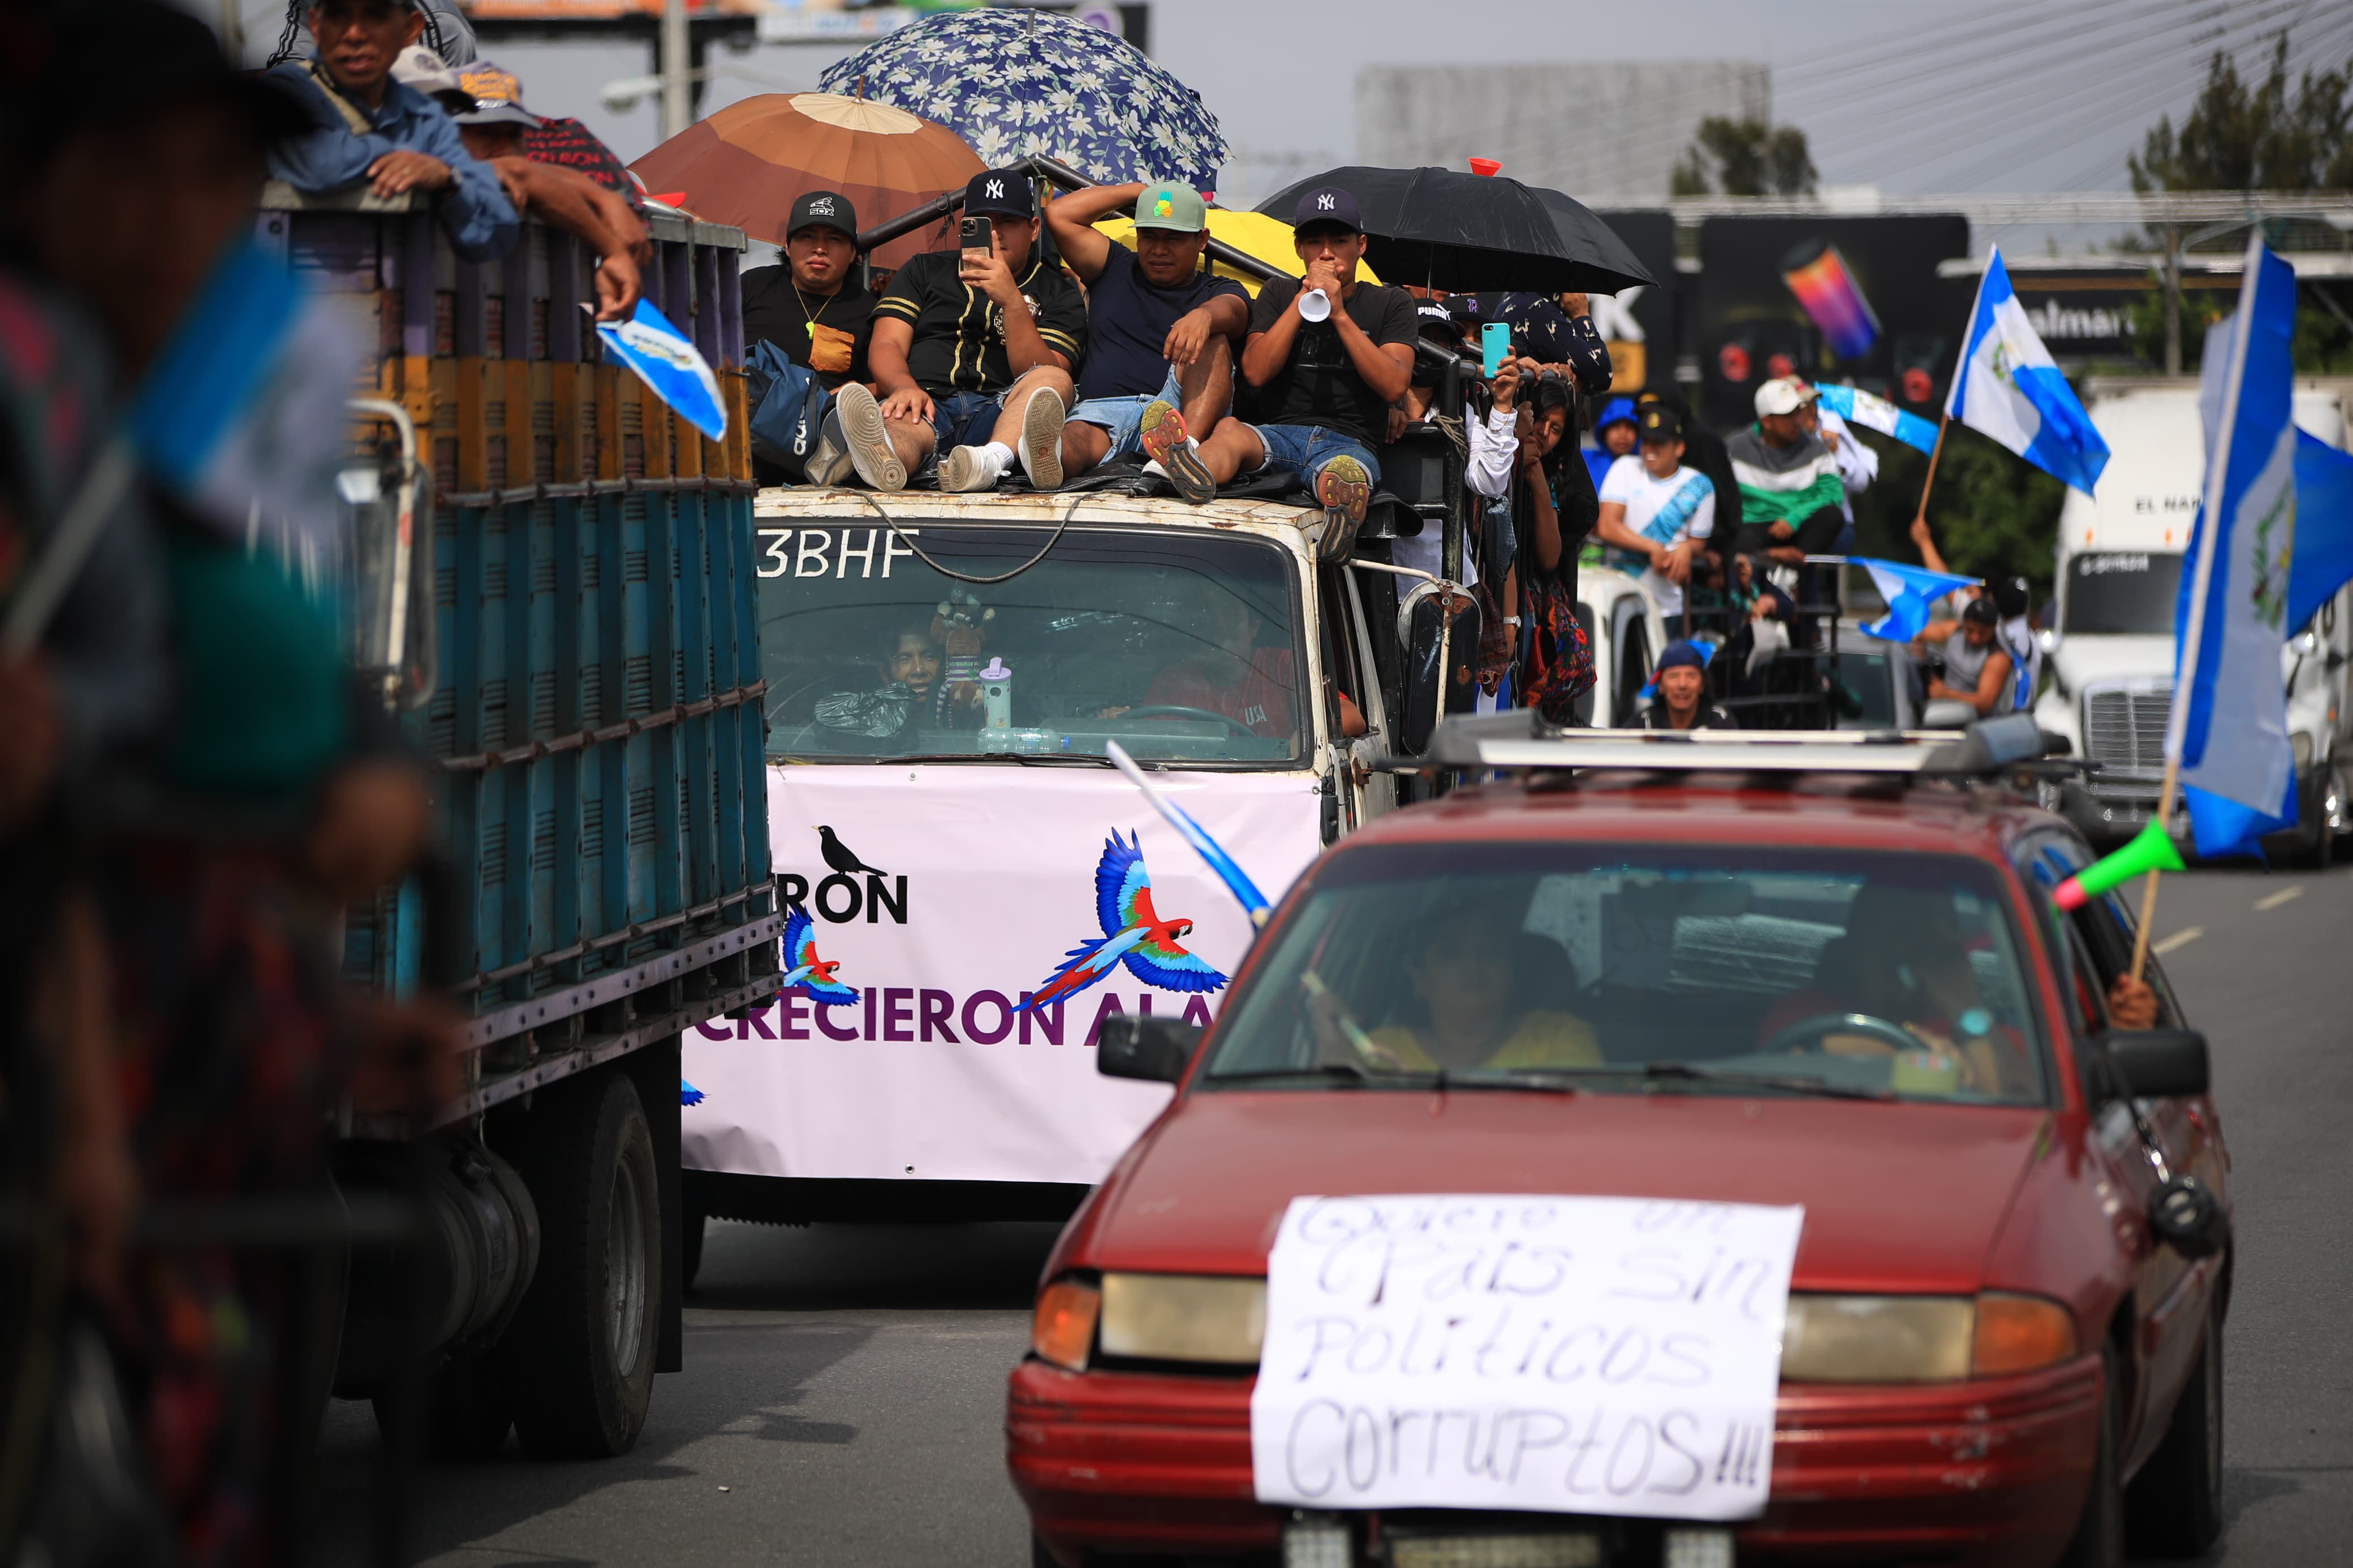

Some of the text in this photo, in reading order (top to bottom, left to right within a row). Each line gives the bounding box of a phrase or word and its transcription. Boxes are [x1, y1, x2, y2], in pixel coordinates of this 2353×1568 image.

[985, 178, 1005, 200] NY
[1317, 193, 1335, 210] NY
[1417, 306, 1448, 321] PUMA
[757, 529, 919, 578] 3BHF
[1244, 704, 1268, 726] USA
